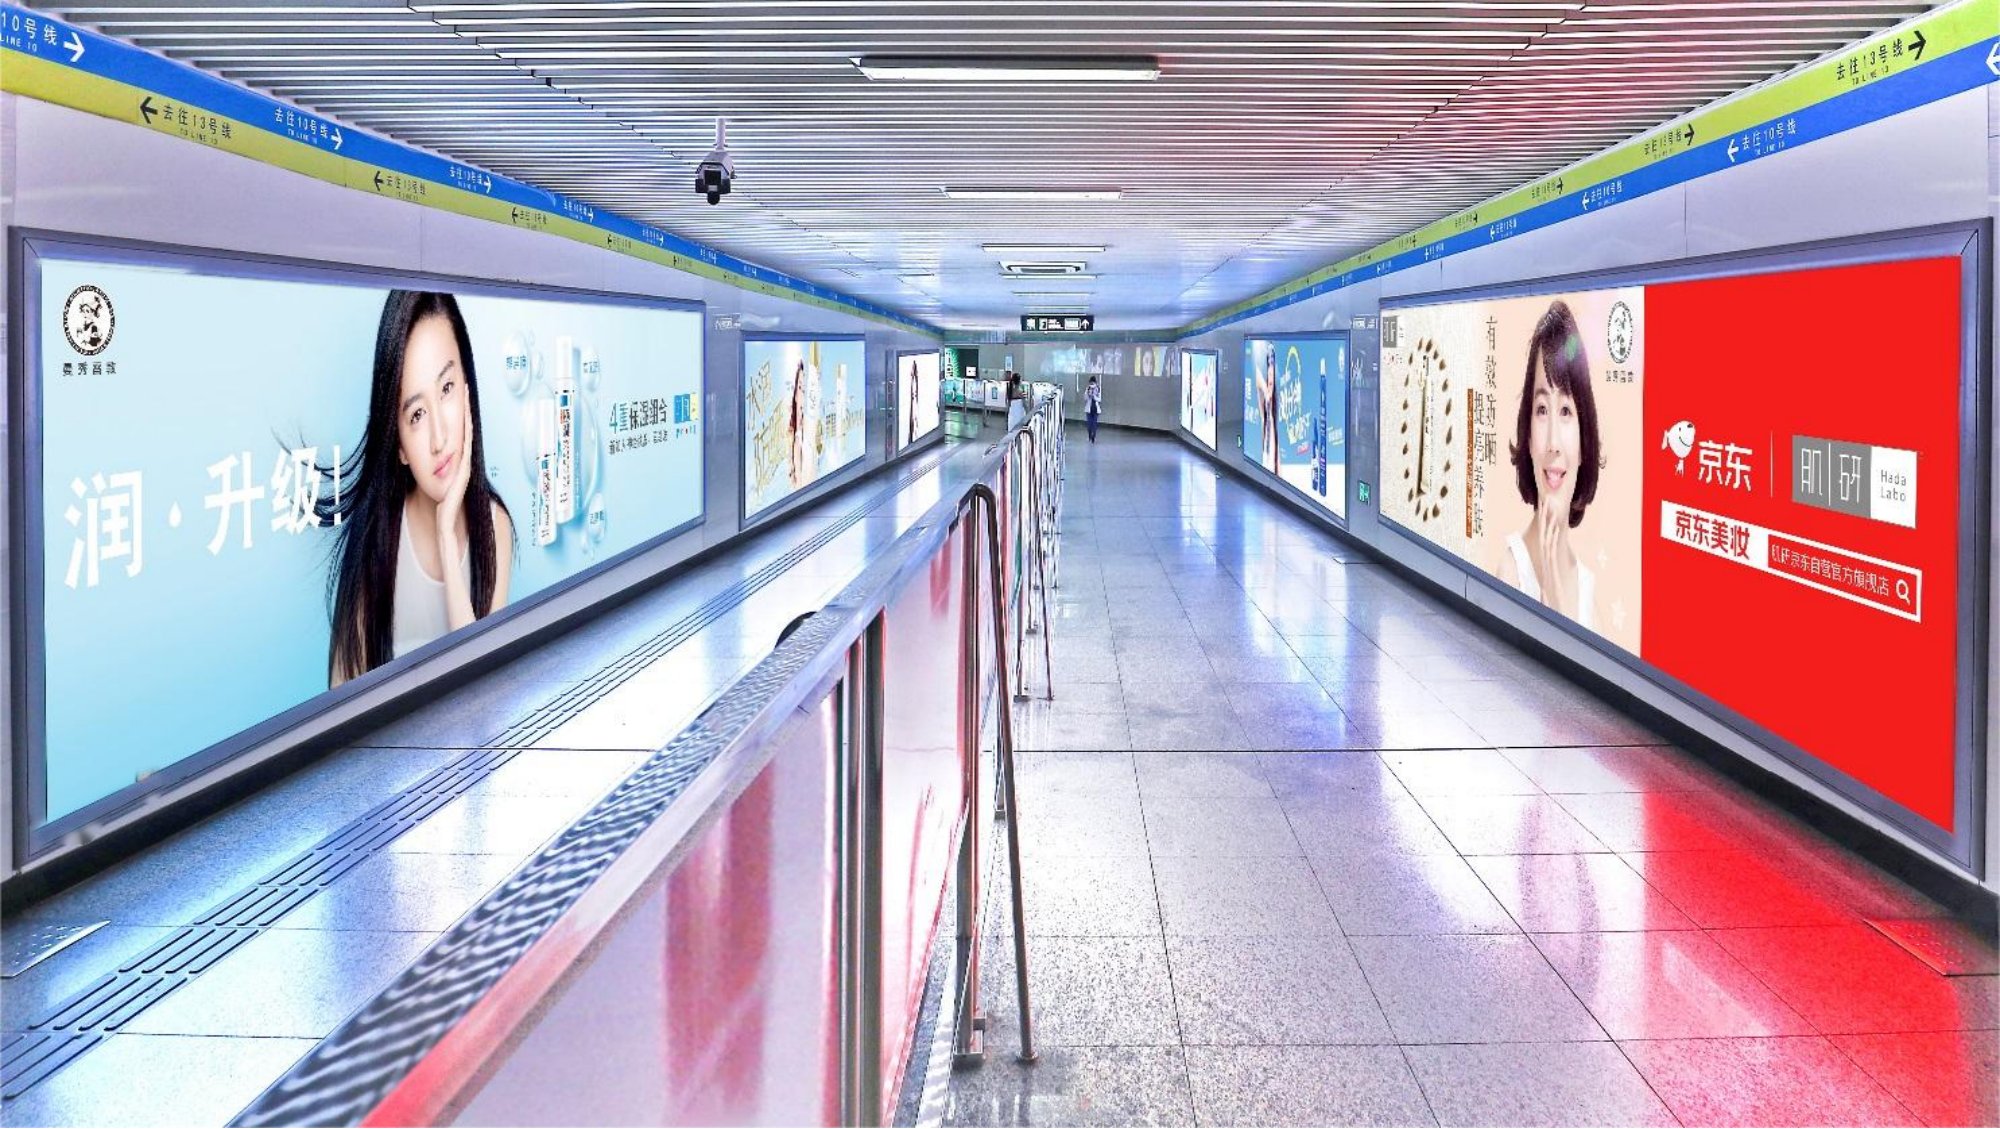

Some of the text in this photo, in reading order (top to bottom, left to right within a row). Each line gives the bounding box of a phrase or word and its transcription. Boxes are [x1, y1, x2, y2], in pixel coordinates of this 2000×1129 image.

[1, 12, 57, 46] 10号线
[1836, 38, 1903, 81] 去往13号线
[163, 104, 232, 139] 去往13号线
[274, 106, 329, 139] 去往10号线
[1742, 118, 1796, 150] 去往10号线
[1698, 440, 1753, 491] 京东
[1880, 469, 1907, 486] Hada
[1880, 487, 1907, 502] Labo
[1675, 510, 1751, 560] 京东美妆
